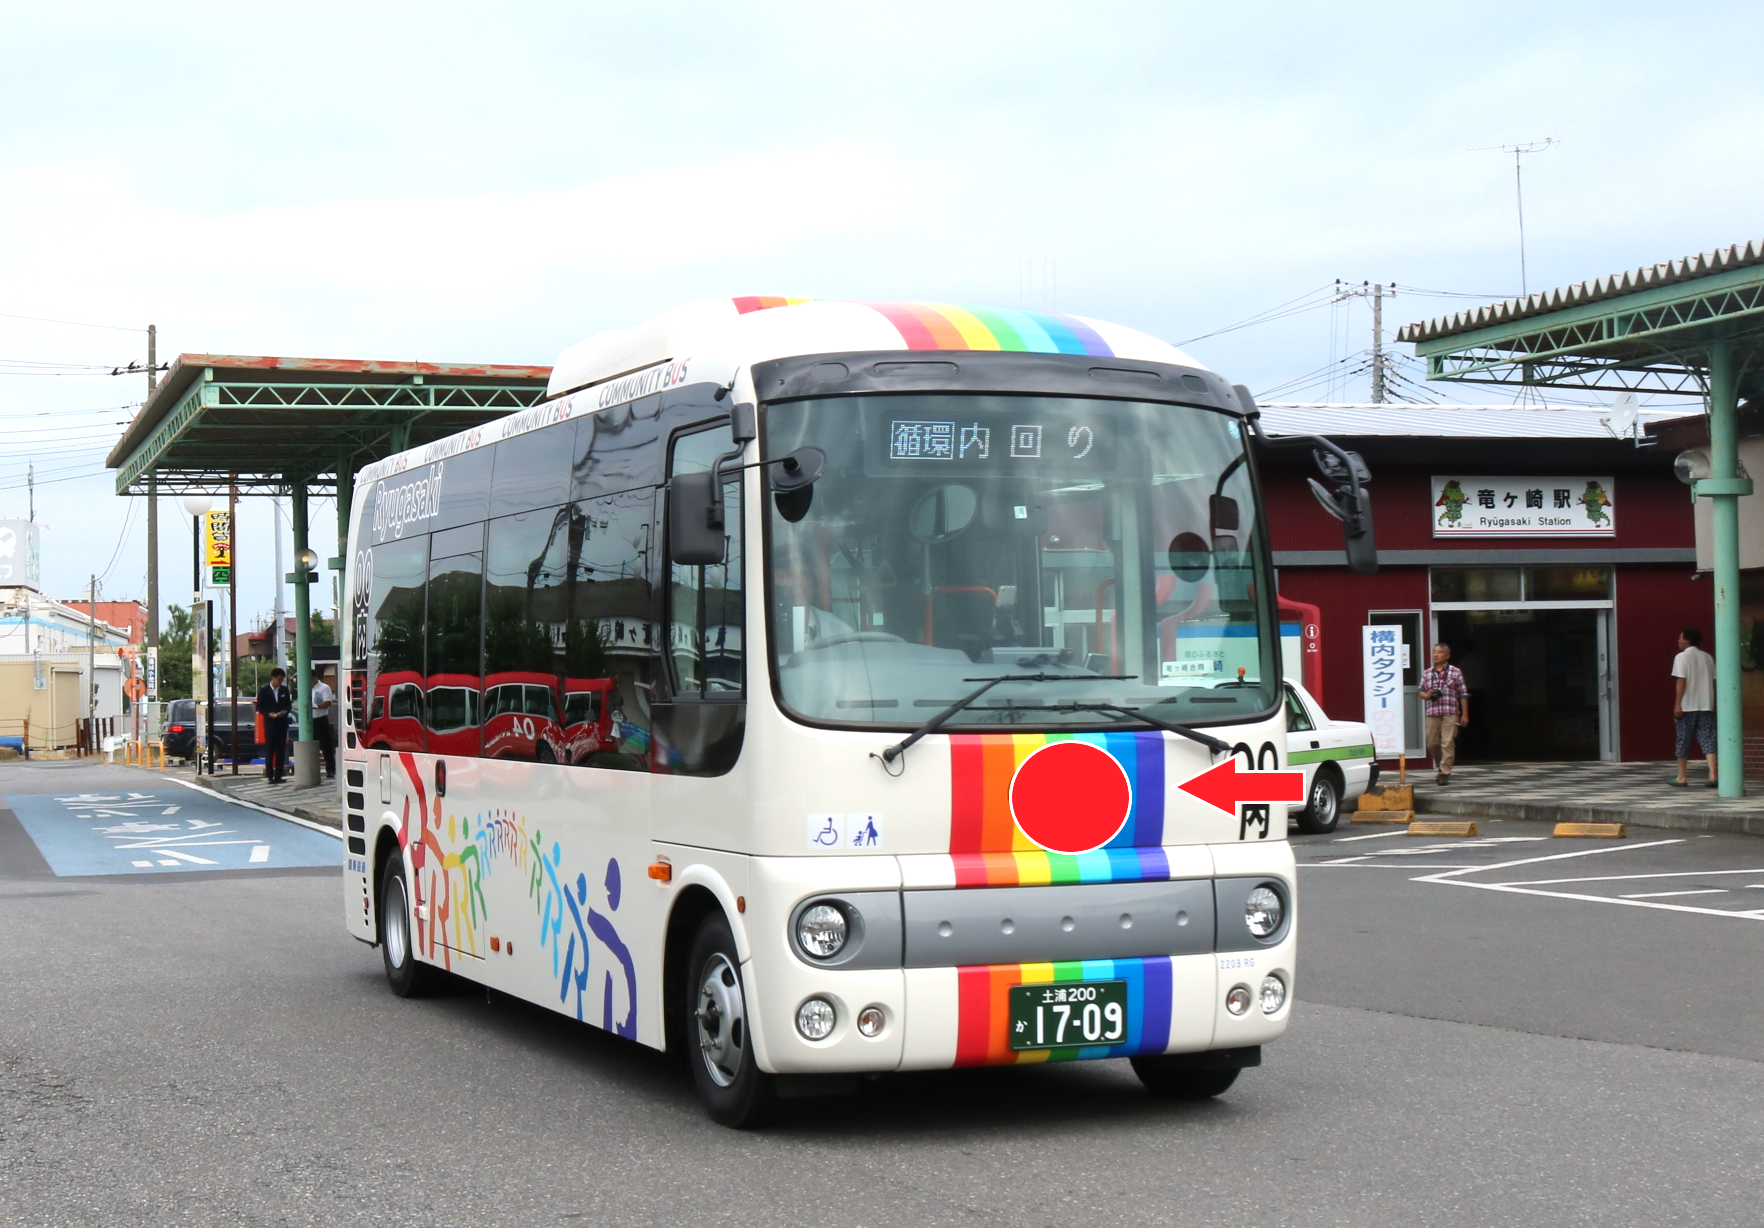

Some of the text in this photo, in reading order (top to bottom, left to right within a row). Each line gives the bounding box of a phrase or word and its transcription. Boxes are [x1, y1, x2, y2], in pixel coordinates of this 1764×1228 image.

[599, 357, 691, 408] COMMUNITY BUS
[502, 396, 576, 438] COMMUNITY BUS
[894, 422, 1094, 459] 循環 内回り
[373, 461, 443, 541] Ryugasaki
[1480, 516, 1531, 527] Ryūgasaki
[1538, 516, 1572, 526] Station
[1042, 987, 1096, 1003] 土浦200
[1015, 1002, 1122, 1044] か 17-09
